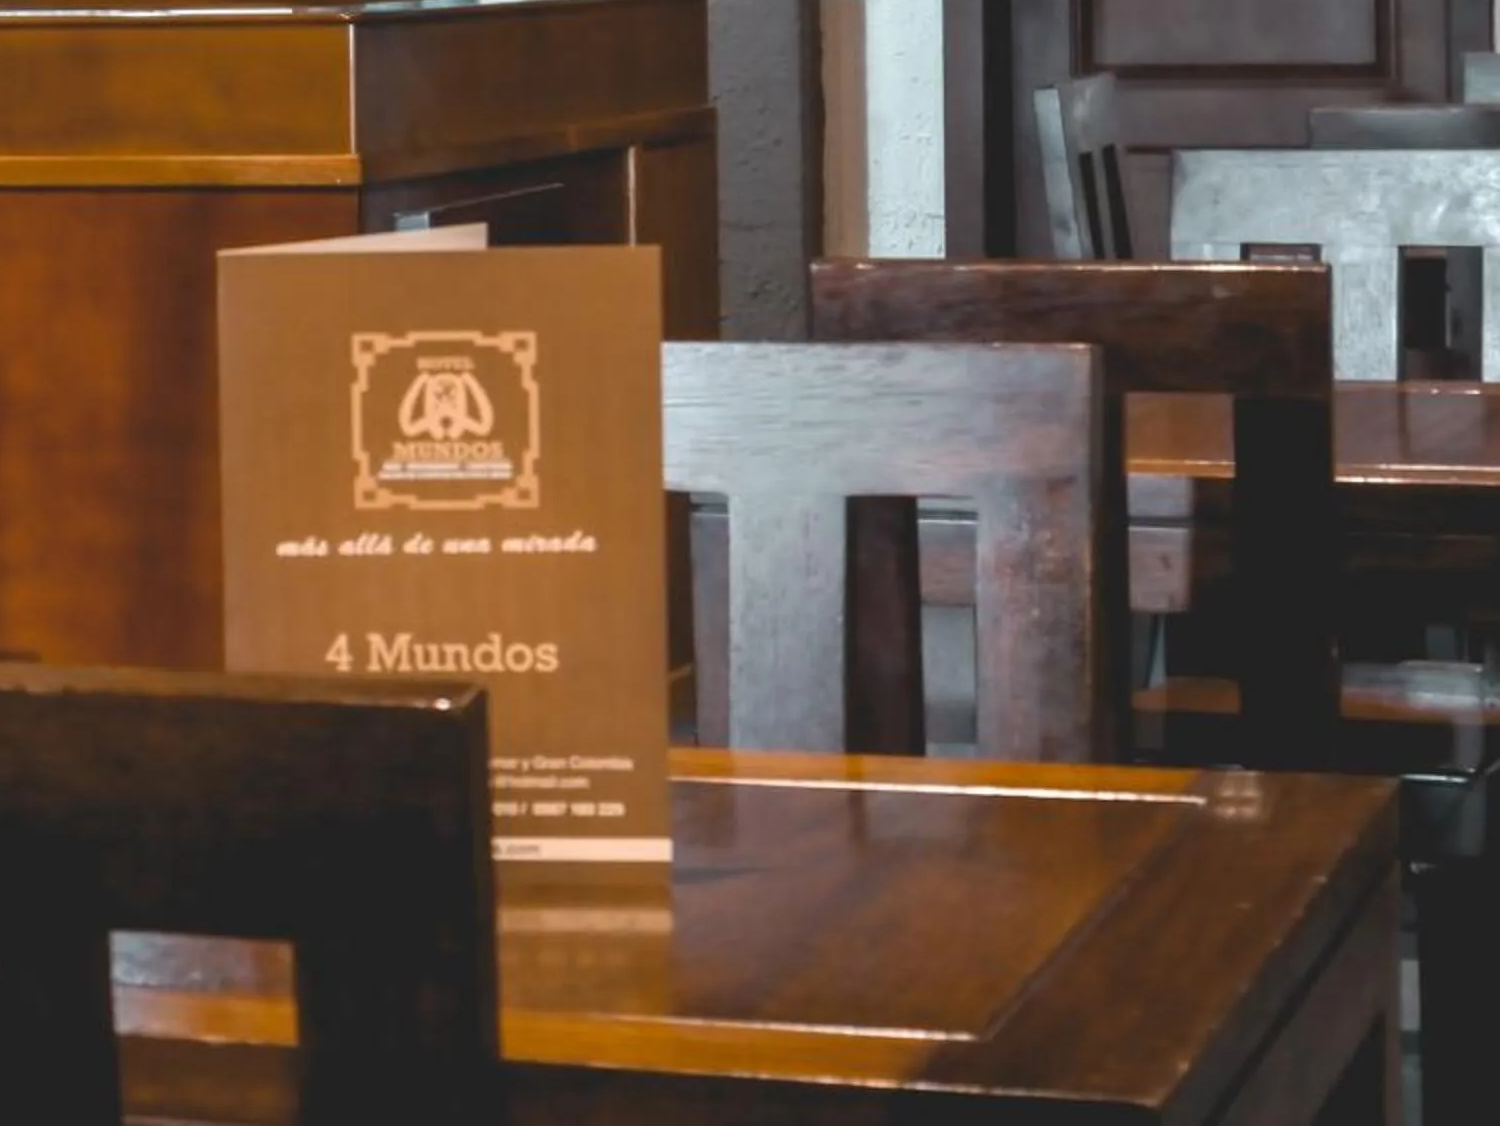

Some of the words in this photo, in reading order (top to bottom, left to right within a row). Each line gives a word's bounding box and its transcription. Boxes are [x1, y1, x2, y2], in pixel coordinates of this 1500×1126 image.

[392, 441, 504, 462] MUNDOS
[402, 532, 434, 554] de
[441, 537, 492, 555] una
[500, 530, 597, 554] mirada
[324, 632, 353, 672] 4
[365, 632, 559, 673] Mundos
